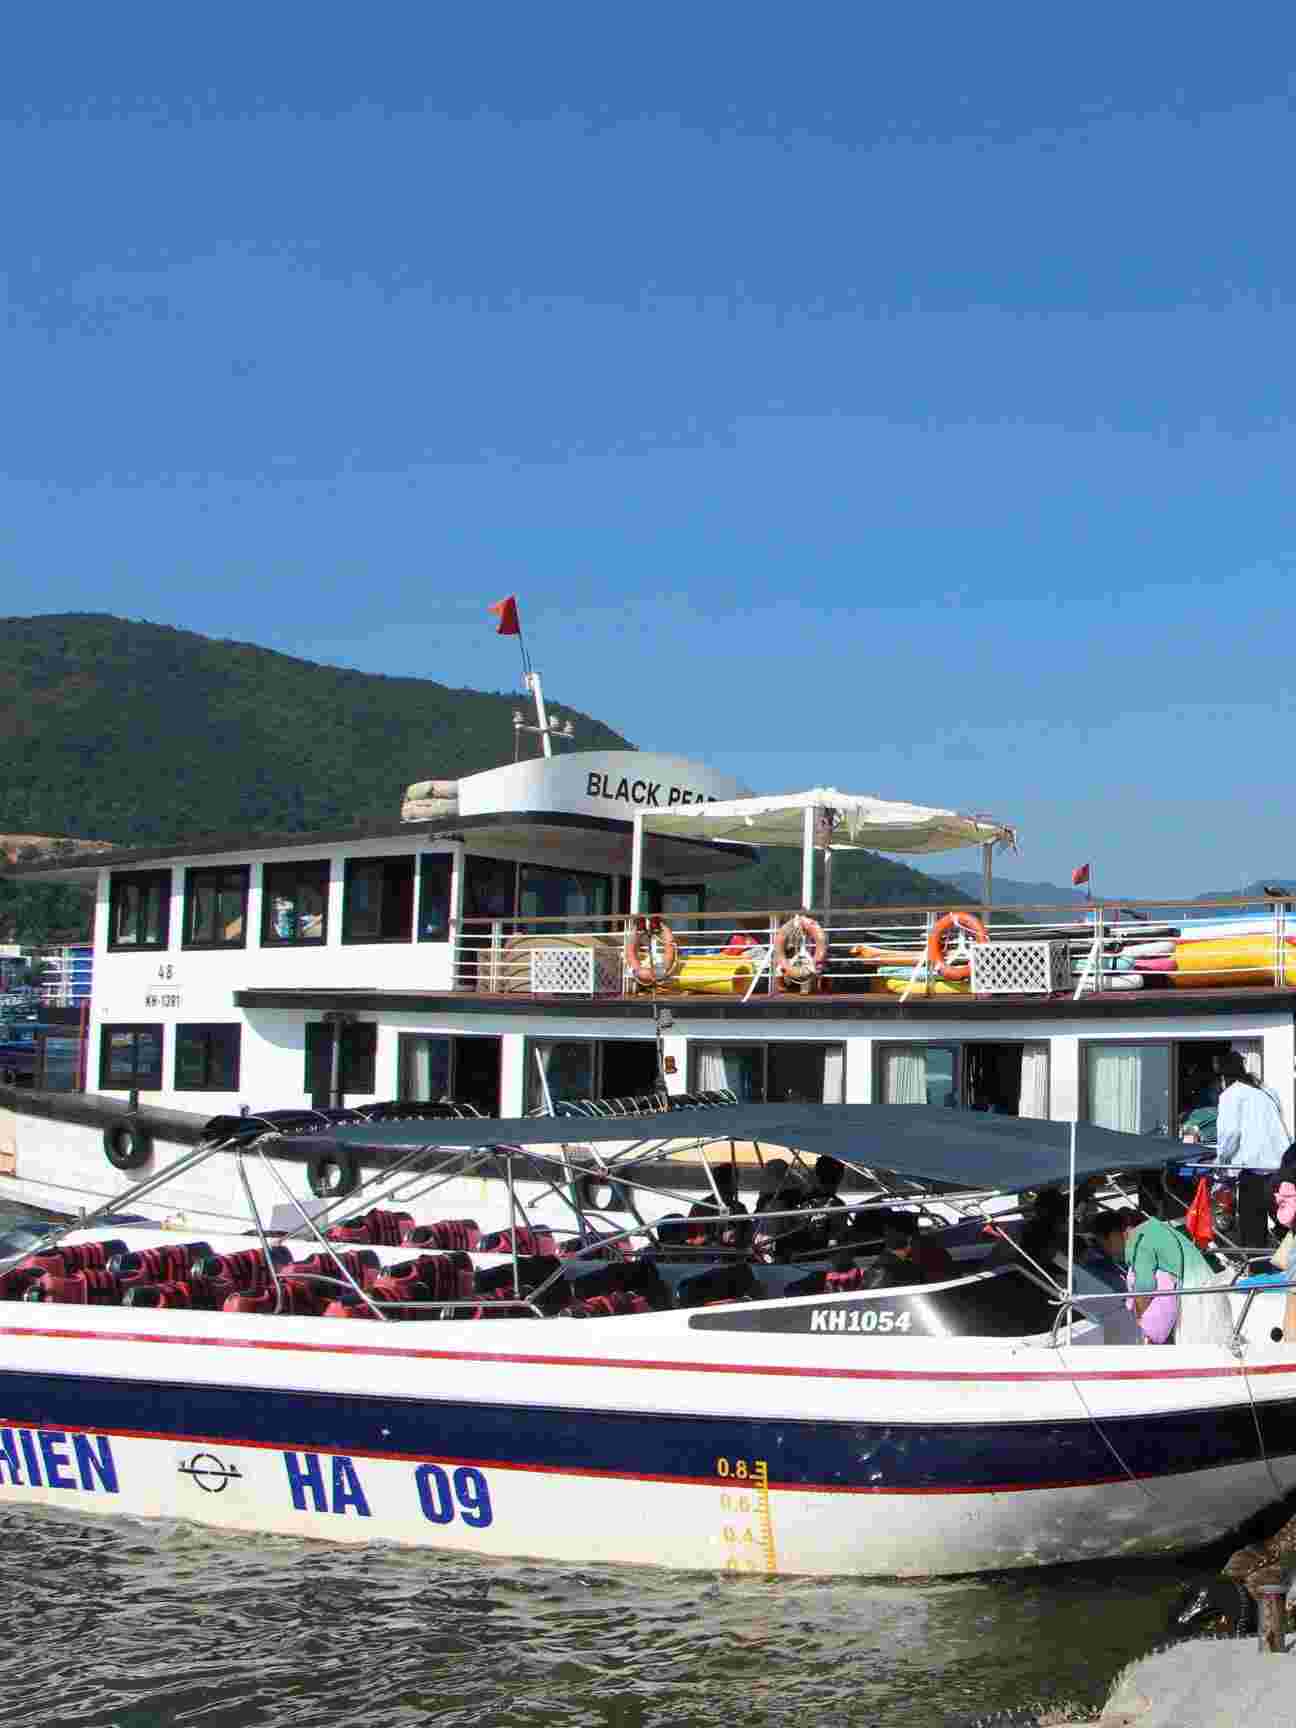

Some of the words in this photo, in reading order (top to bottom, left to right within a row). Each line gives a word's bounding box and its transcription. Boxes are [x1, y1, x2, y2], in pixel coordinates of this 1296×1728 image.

[586, 771, 661, 808] BLACK
[667, 786, 720, 807] PEA
[810, 1309, 912, 1332] KH1054
[283, 1451, 371, 1517] HA
[414, 1463, 494, 1529] 09
